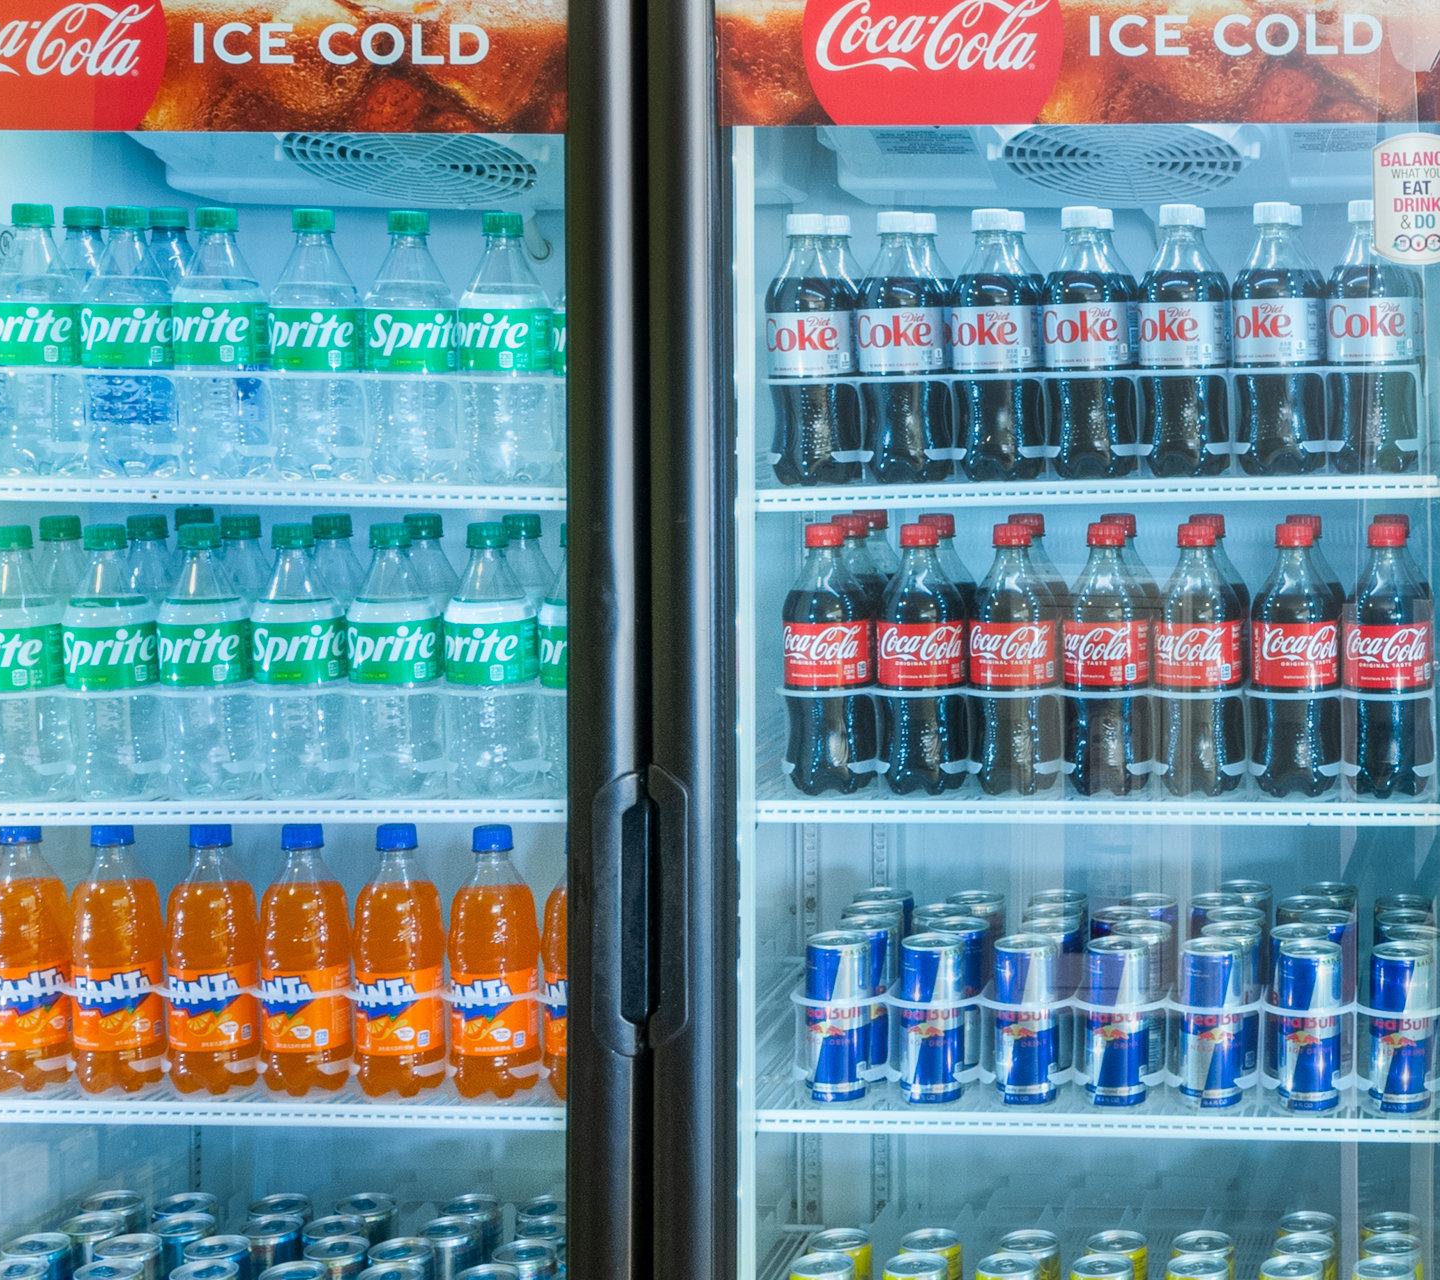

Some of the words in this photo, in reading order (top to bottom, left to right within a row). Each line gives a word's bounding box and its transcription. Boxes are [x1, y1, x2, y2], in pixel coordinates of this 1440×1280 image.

[193, 22, 295, 65] ICE
[319, 22, 490, 66] COLD
[1089, 15, 1189, 56] ICE
[1214, 15, 1383, 56] COLD
[1391, 168, 1420, 179] WHAT
[1401, 214, 1411, 229] &
[1415, 214, 1435, 229] DO
[806, 316, 830, 326] Diet
[901, 312, 924, 323] Diet
[985, 310, 1009, 321] Diet
[1089, 307, 1112, 318] Diet
[1167, 306, 1190, 317] Diet
[1260, 302, 1284, 314] Diet
[1328, 304, 1406, 339] Coke
[1379, 301, 1400, 314] Diet
[767, 318, 839, 352] Coke
[859, 315, 934, 348] Coke
[1043, 309, 1120, 345] Coke
[253, 625, 345, 671] Sprite
[348, 625, 435, 669] Sprite
[783, 624, 861, 659] Coca-Cola
[880, 625, 962, 661] Coca-Cola
[970, 624, 1050, 660] Coca-Cola
[1347, 626, 1427, 663] Coca-Cola
[76, 970, 149, 1004] FANTA
[1399, 1017, 1429, 1031] Bull
